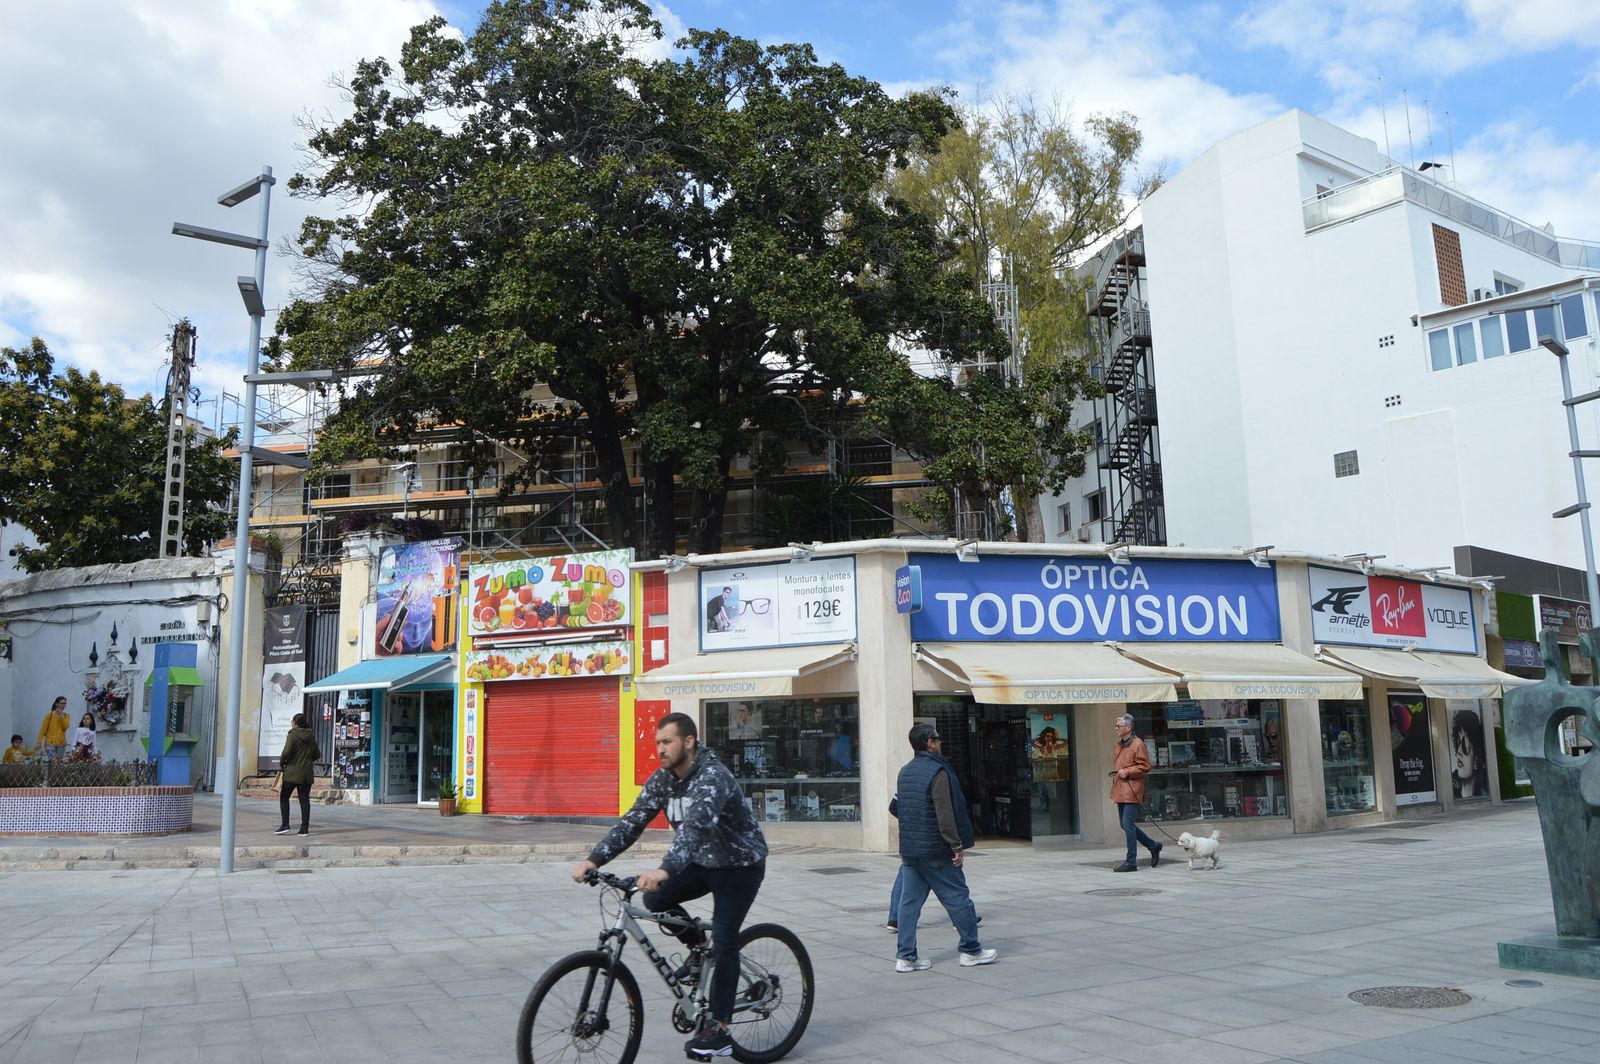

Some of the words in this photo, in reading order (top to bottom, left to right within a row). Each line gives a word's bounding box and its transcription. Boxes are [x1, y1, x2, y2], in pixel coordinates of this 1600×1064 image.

[784, 575, 818, 584] Montura
[826, 572, 852, 581] lentes
[897, 575, 910, 588] vision
[1041, 560, 1149, 590] ÓPTICA
[793, 584, 845, 595] monofocales
[804, 598, 842, 619] 129€
[936, 593, 1247, 635] TODOVISION
[1329, 613, 1370, 628] arnette
[664, 685, 697, 696] OPTICA
[698, 682, 756, 694] TODOVISION
[1025, 690, 1063, 700] OPTICA
[1065, 688, 1128, 699] TODOVISION
[1235, 685, 1268, 695] OPTICA
[1269, 685, 1320, 695] TODOVISION
